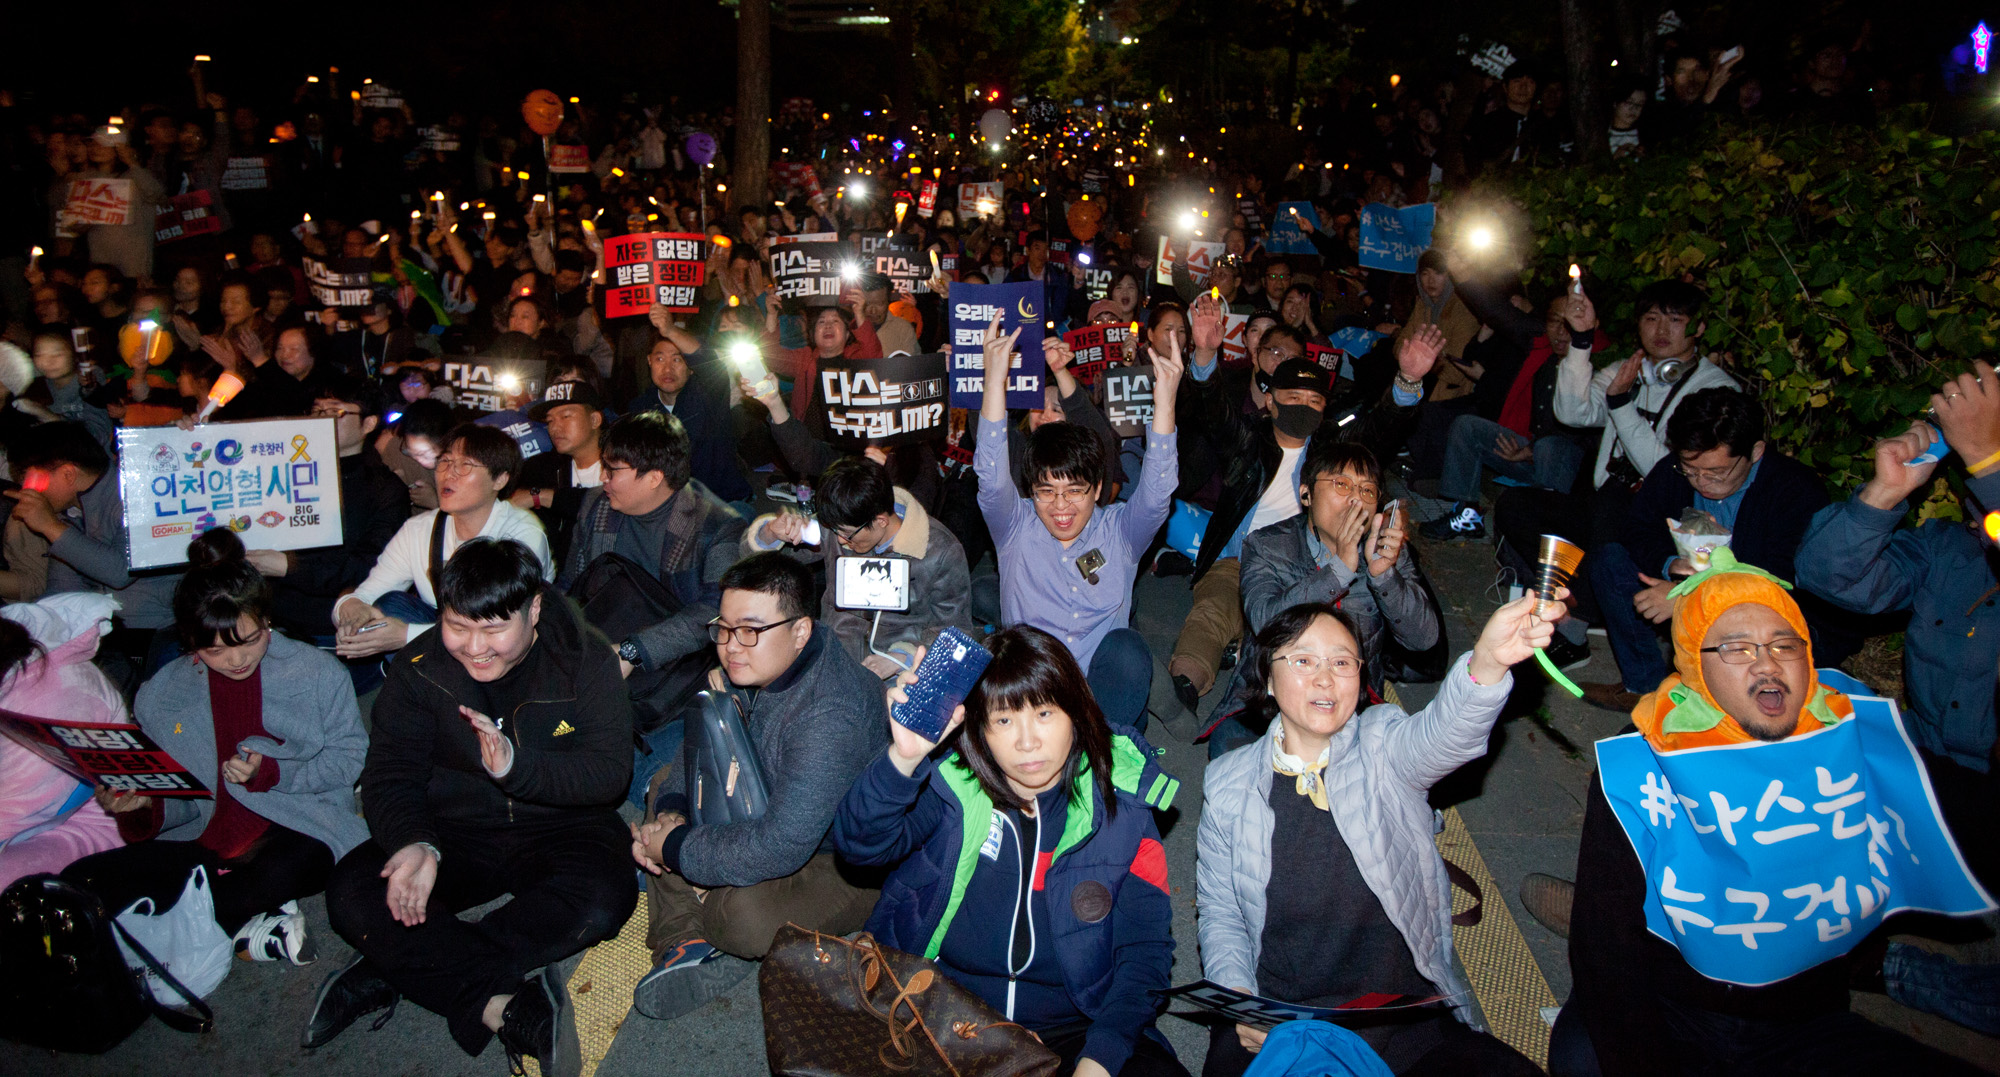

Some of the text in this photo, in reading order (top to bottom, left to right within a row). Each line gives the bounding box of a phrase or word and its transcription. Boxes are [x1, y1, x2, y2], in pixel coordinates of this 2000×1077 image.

[616, 240, 698, 262] 자유 없당!
[617, 264, 697, 286] 받은 정당!
[771, 250, 821, 278] 다스는
[876, 256, 920, 277] 다스는
[1085, 268, 1113, 289] 다스
[619, 286, 696, 306] 국민 없당!
[1074, 331, 1100, 347] 자유
[1075, 346, 1103, 366] 받은
[821, 370, 902, 407] 다스는
[1107, 374, 1157, 403] 다스
[828, 403, 944, 439] 누구겁니까?
[1109, 404, 1155, 427] 누구겁
[151, 461, 320, 517] 인천열혈시민
[295, 504, 314, 515] BIG
[290, 514, 320, 528] ISSUE
[51, 726, 145, 750] 없당!
[97, 773, 192, 791] 없당!
[1639, 766, 1869, 846] #다스는
